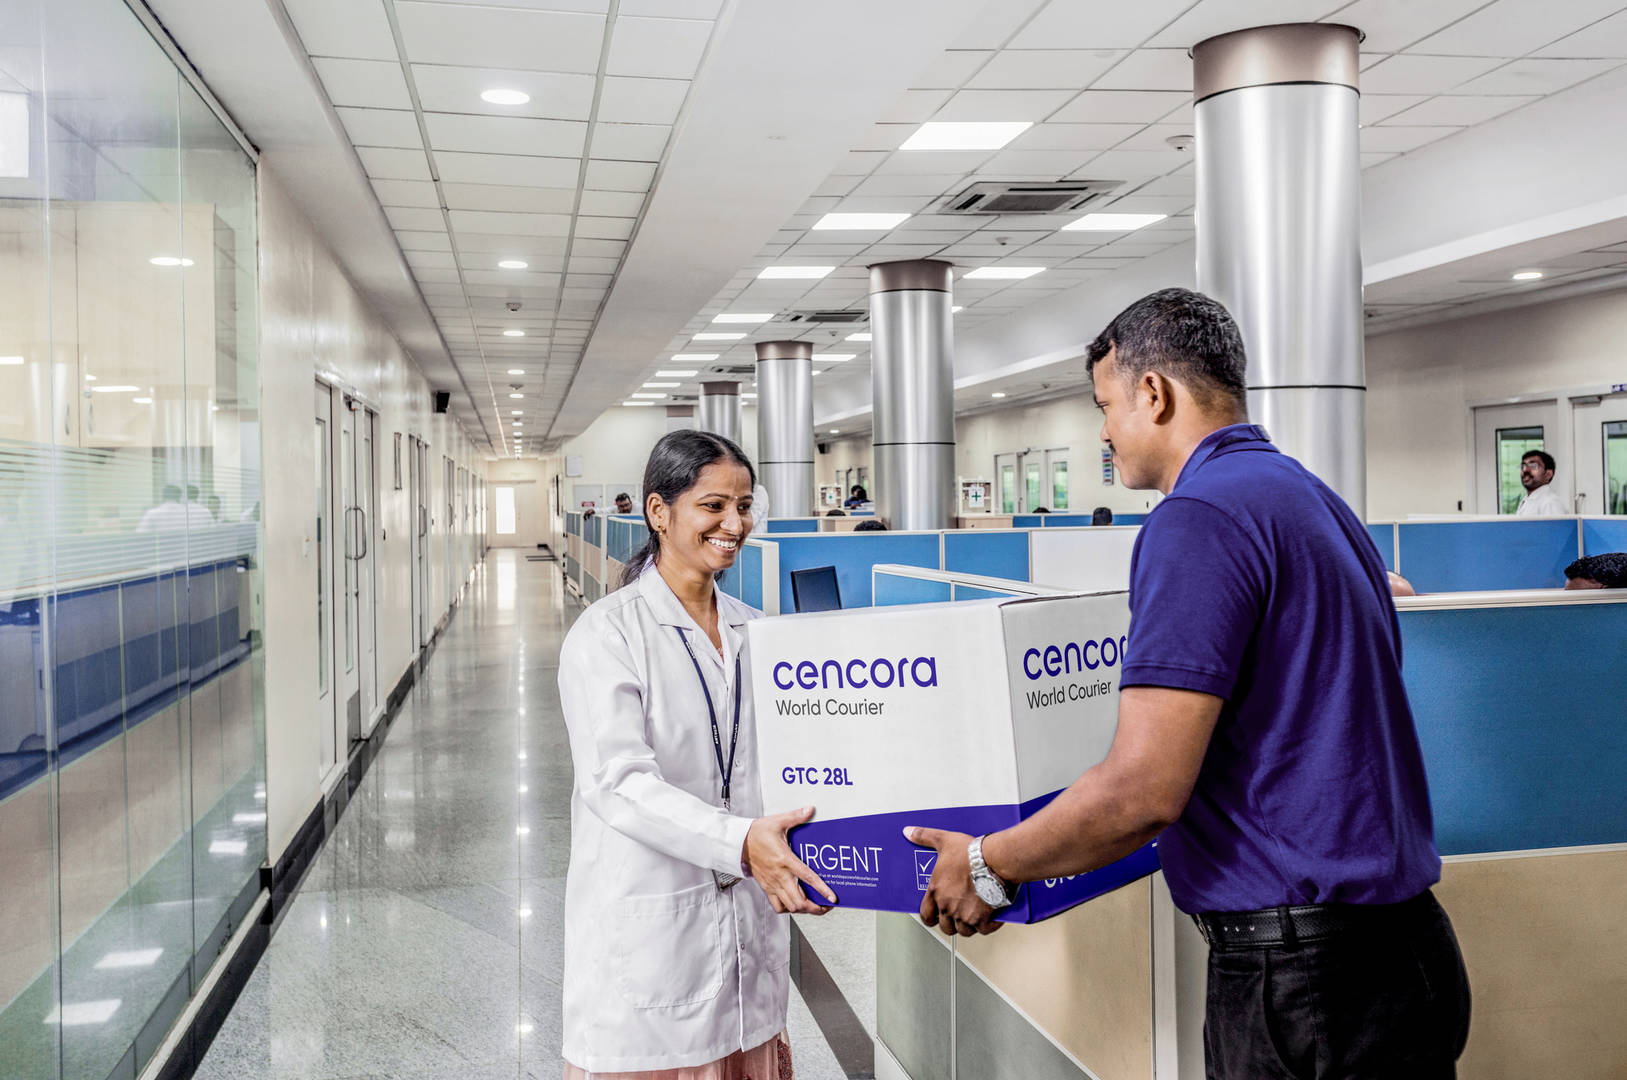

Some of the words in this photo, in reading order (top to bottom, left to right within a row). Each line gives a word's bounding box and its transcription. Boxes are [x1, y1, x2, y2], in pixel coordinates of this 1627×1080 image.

[1023, 635, 1126, 680] cencor
[773, 656, 938, 690] cencora
[776, 699, 821, 716] World
[825, 699, 884, 716] Courier
[1026, 686, 1065, 709] World
[1068, 680, 1112, 701] Courier
[782, 766, 819, 785] GTC
[823, 767, 853, 786] 28L
